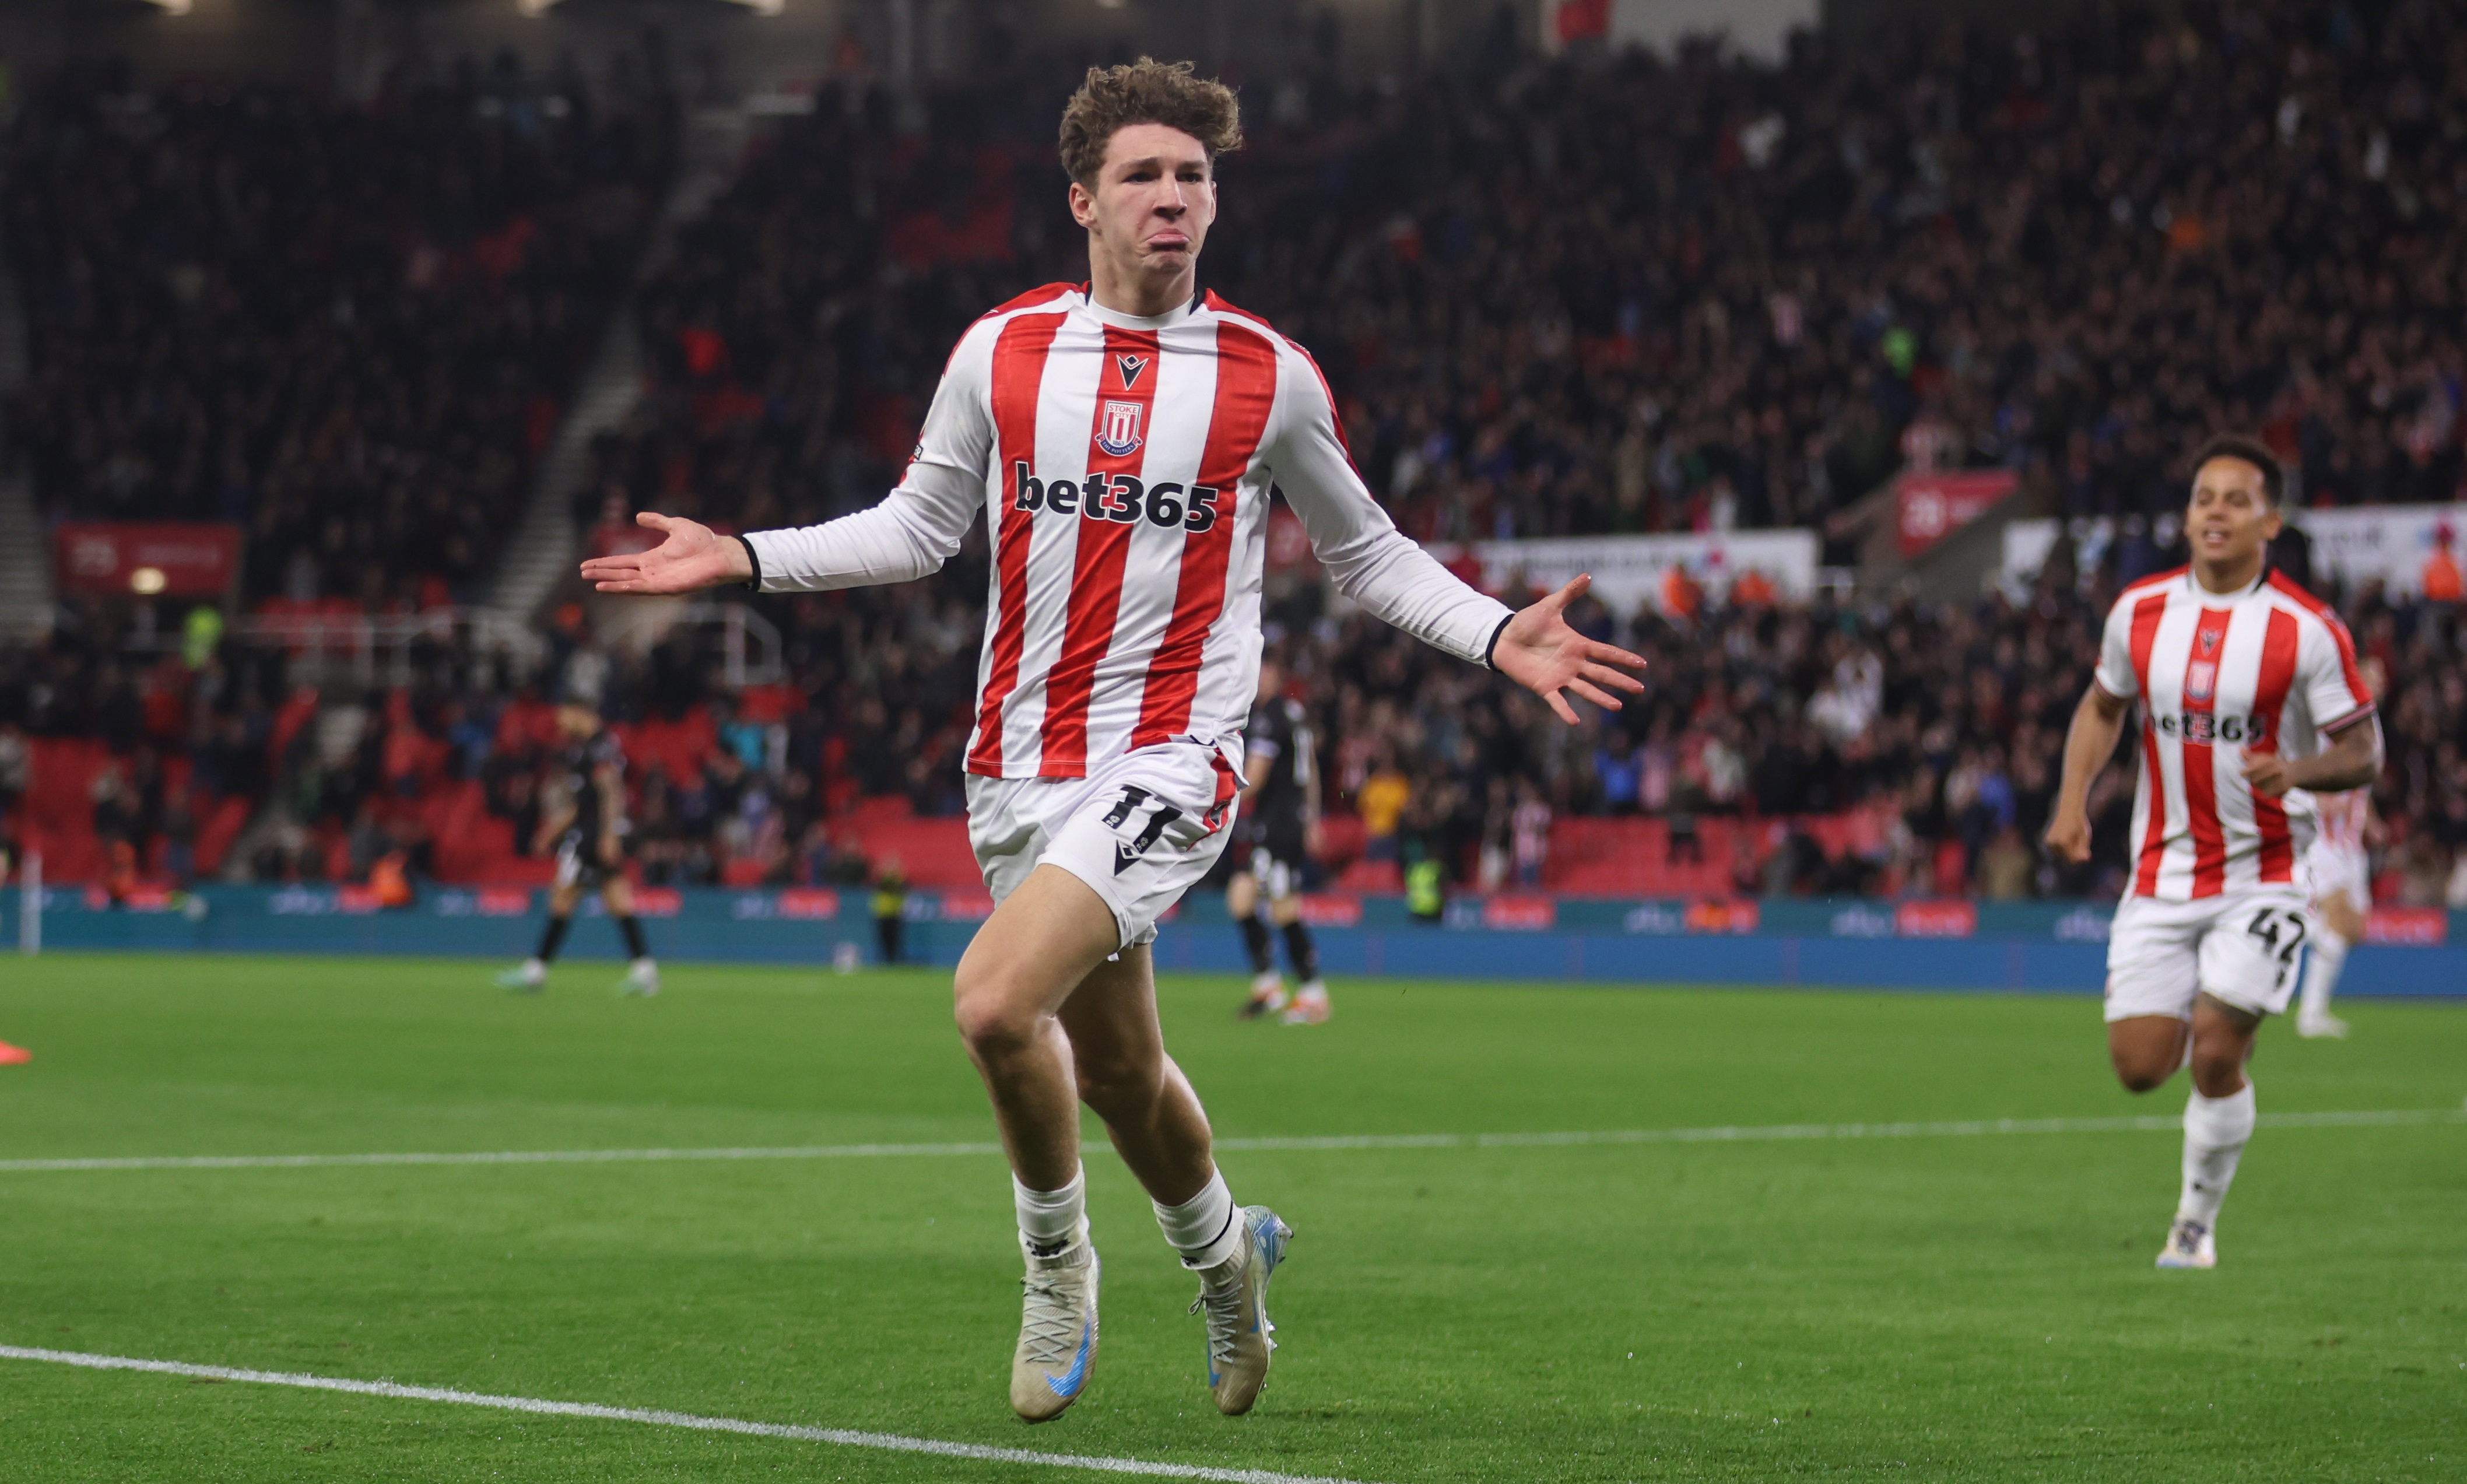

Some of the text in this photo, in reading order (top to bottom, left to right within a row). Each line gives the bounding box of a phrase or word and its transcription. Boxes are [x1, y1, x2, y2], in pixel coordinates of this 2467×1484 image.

[1109, 405, 1138, 413] STOKE
[1111, 444, 1134, 454] POTTERS
[1016, 461, 1219, 533] bet365
[1101, 784, 1184, 855] 11
[2248, 908, 2305, 964] 42
